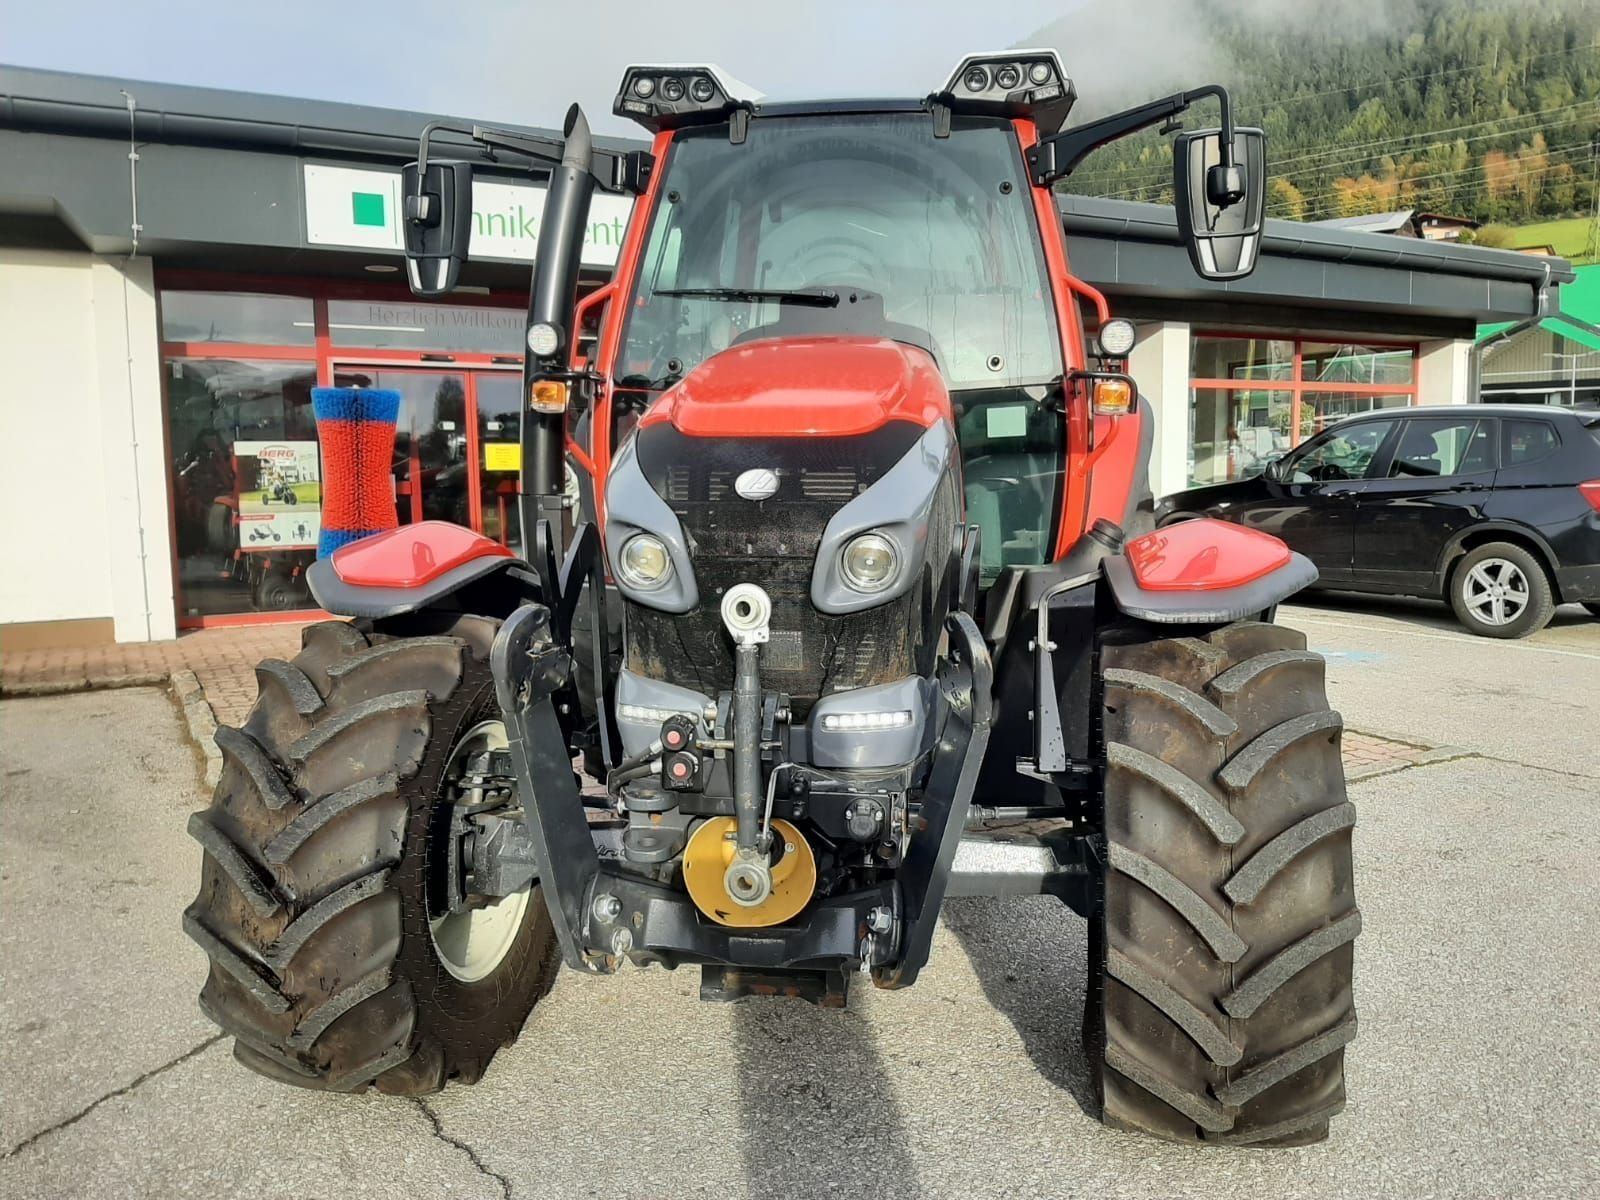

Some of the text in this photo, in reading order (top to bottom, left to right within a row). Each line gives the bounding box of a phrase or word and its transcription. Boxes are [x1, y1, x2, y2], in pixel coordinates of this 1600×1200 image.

[368, 305, 526, 329] Herzlich Willkom
[258, 449, 296, 458] BERG
